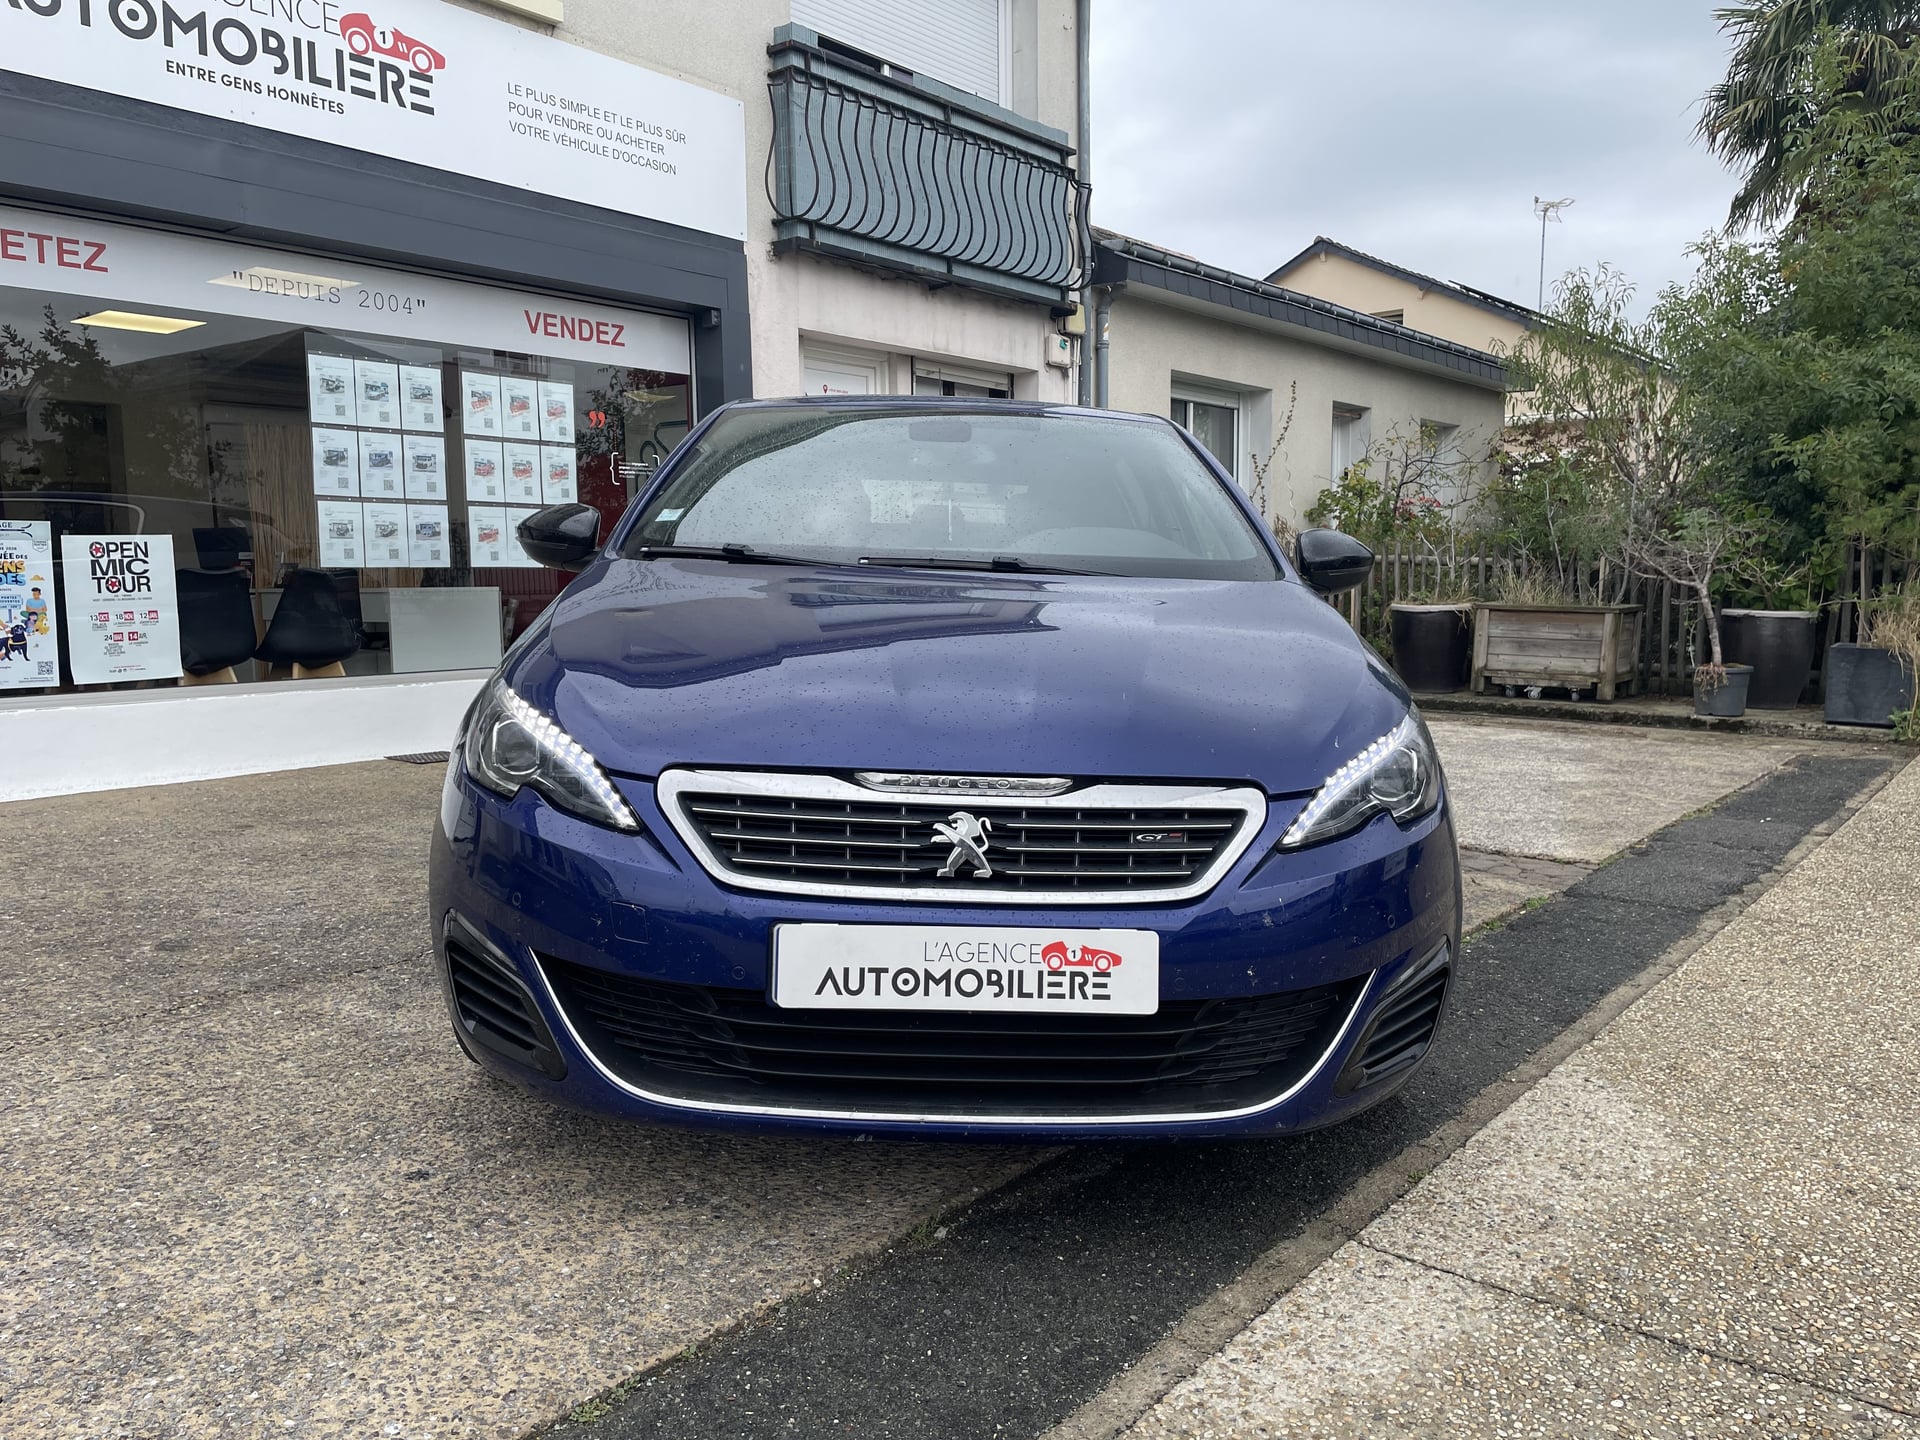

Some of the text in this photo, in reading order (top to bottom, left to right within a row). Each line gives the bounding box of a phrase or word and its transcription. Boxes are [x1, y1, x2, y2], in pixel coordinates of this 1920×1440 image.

[231, 0, 341, 36] NCE
[379, 31, 387, 45] 1
[8, 0, 435, 116] OMOBILIERE
[166, 59, 345, 115] ENTRE GENS HONNÊTES
[507, 82, 687, 145] LE PLUS SIMPLE ET LE PLUS SÛR
[508, 101, 665, 156] POUR VENDRE OU ACHETER
[509, 120, 677, 175] VOTRE VÉHICULE D'OCCASION
[0, 228, 109, 273] ETEZ
[524, 309, 626, 347] VENDEZ
[0, 560, 26, 574] NS
[88, 541, 149, 558] OPEN
[90, 558, 150, 576] MIC
[91, 576, 152, 594] TOUR
[899, 774, 1029, 790] PEUGEOT
[924, 941, 1042, 964] L'AGENCE
[1071, 949, 1077, 959] 1
[815, 966, 1112, 1001] AUTOMOBILIERE
